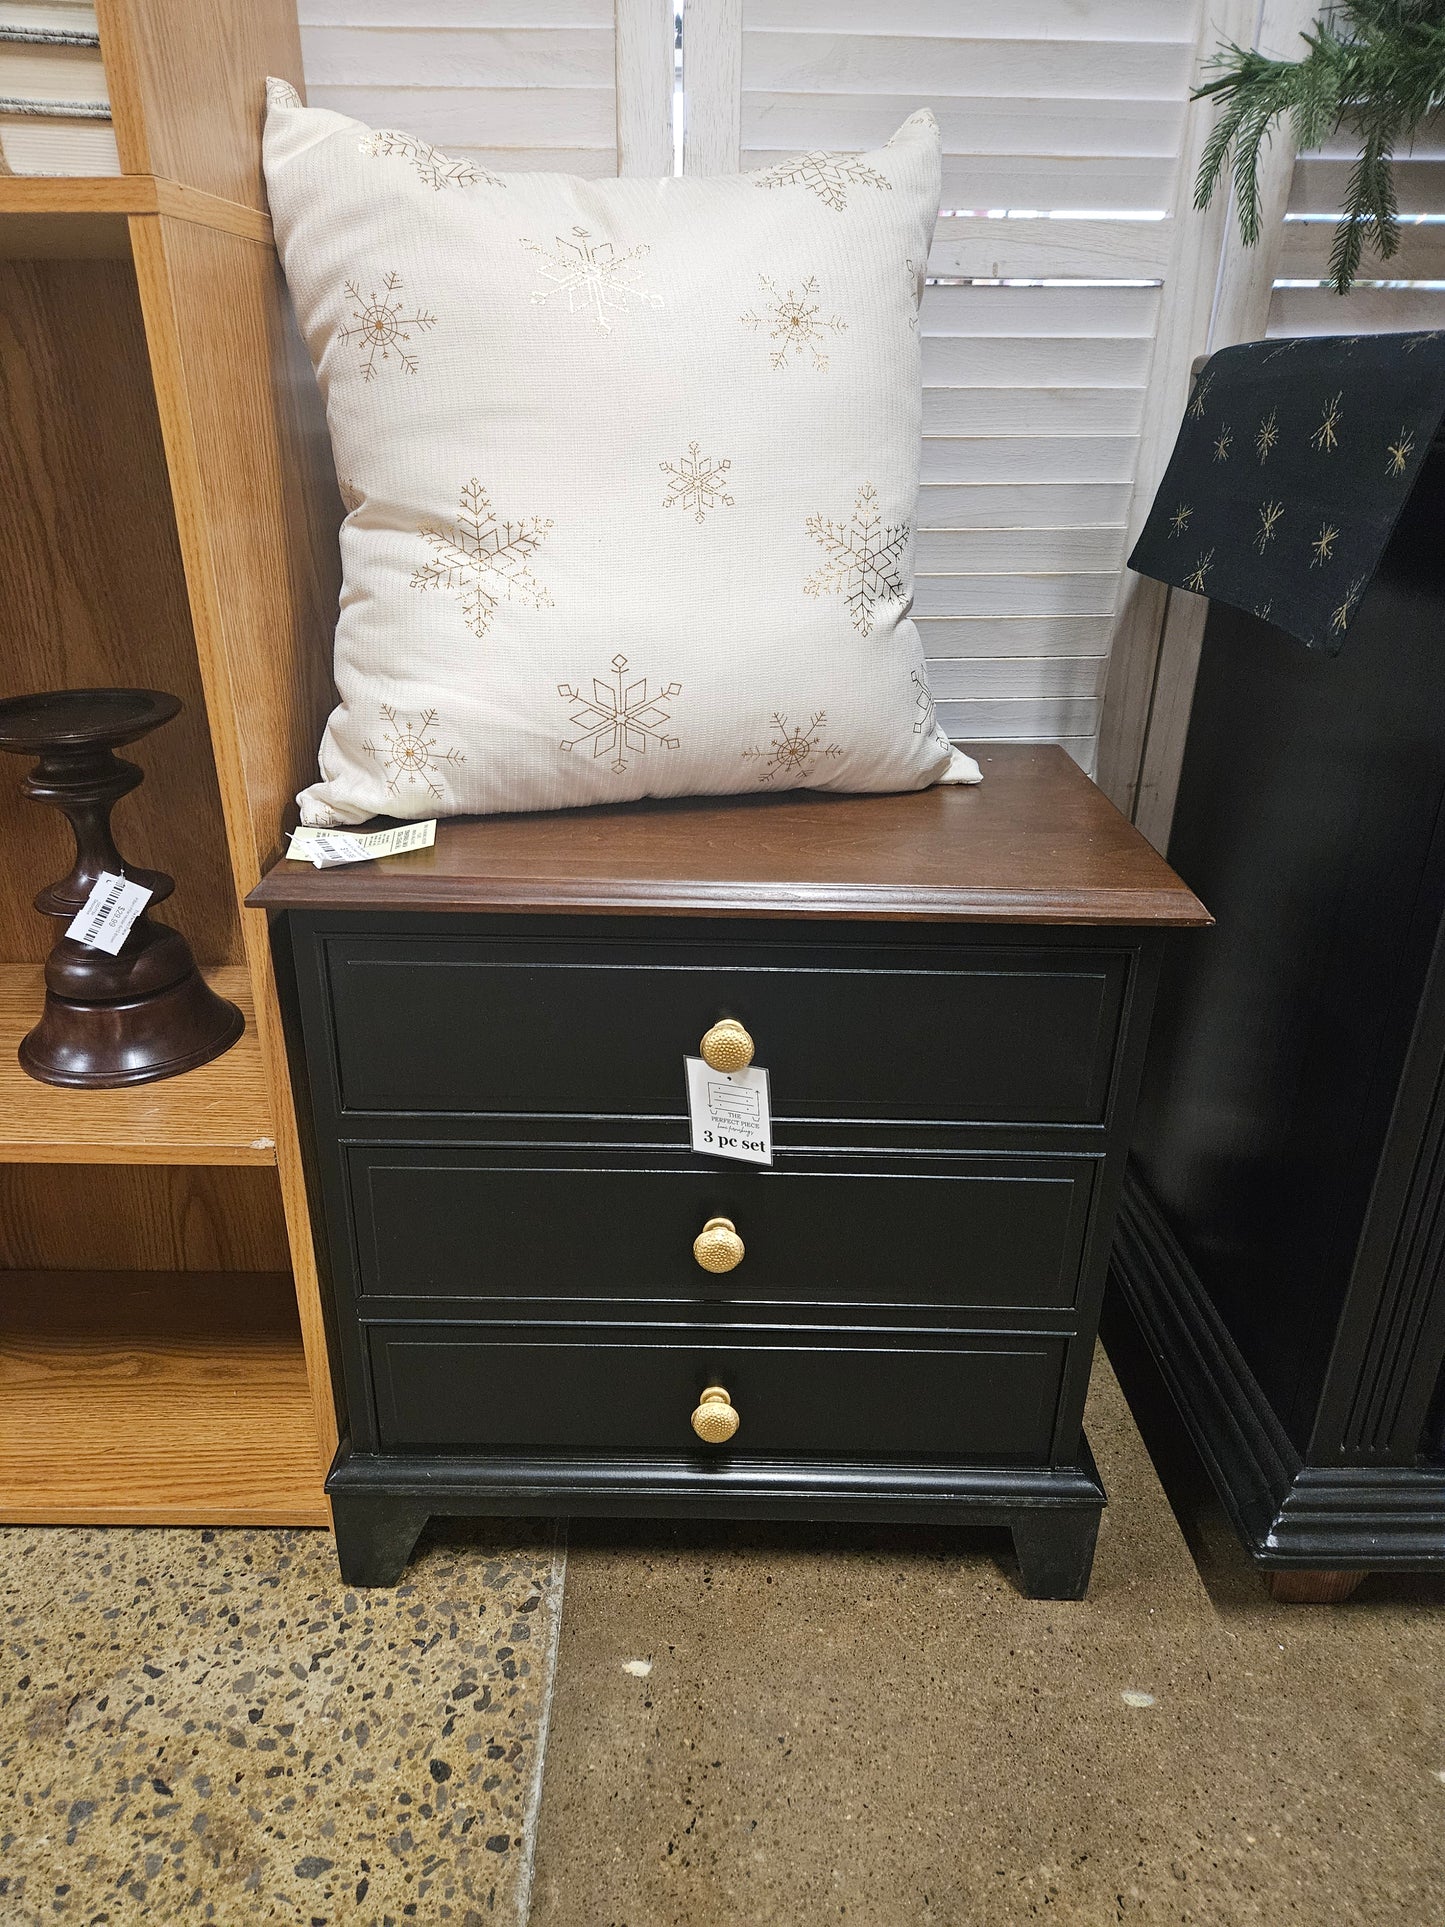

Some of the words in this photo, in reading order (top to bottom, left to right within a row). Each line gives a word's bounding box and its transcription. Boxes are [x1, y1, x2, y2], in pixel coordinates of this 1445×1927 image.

[711, 1116, 739, 1126] PERFECT
[741, 1120, 760, 1129] PIECE
[704, 1130, 713, 1143] 3
[718, 1136, 737, 1148] pc
[742, 1141, 765, 1152] set
